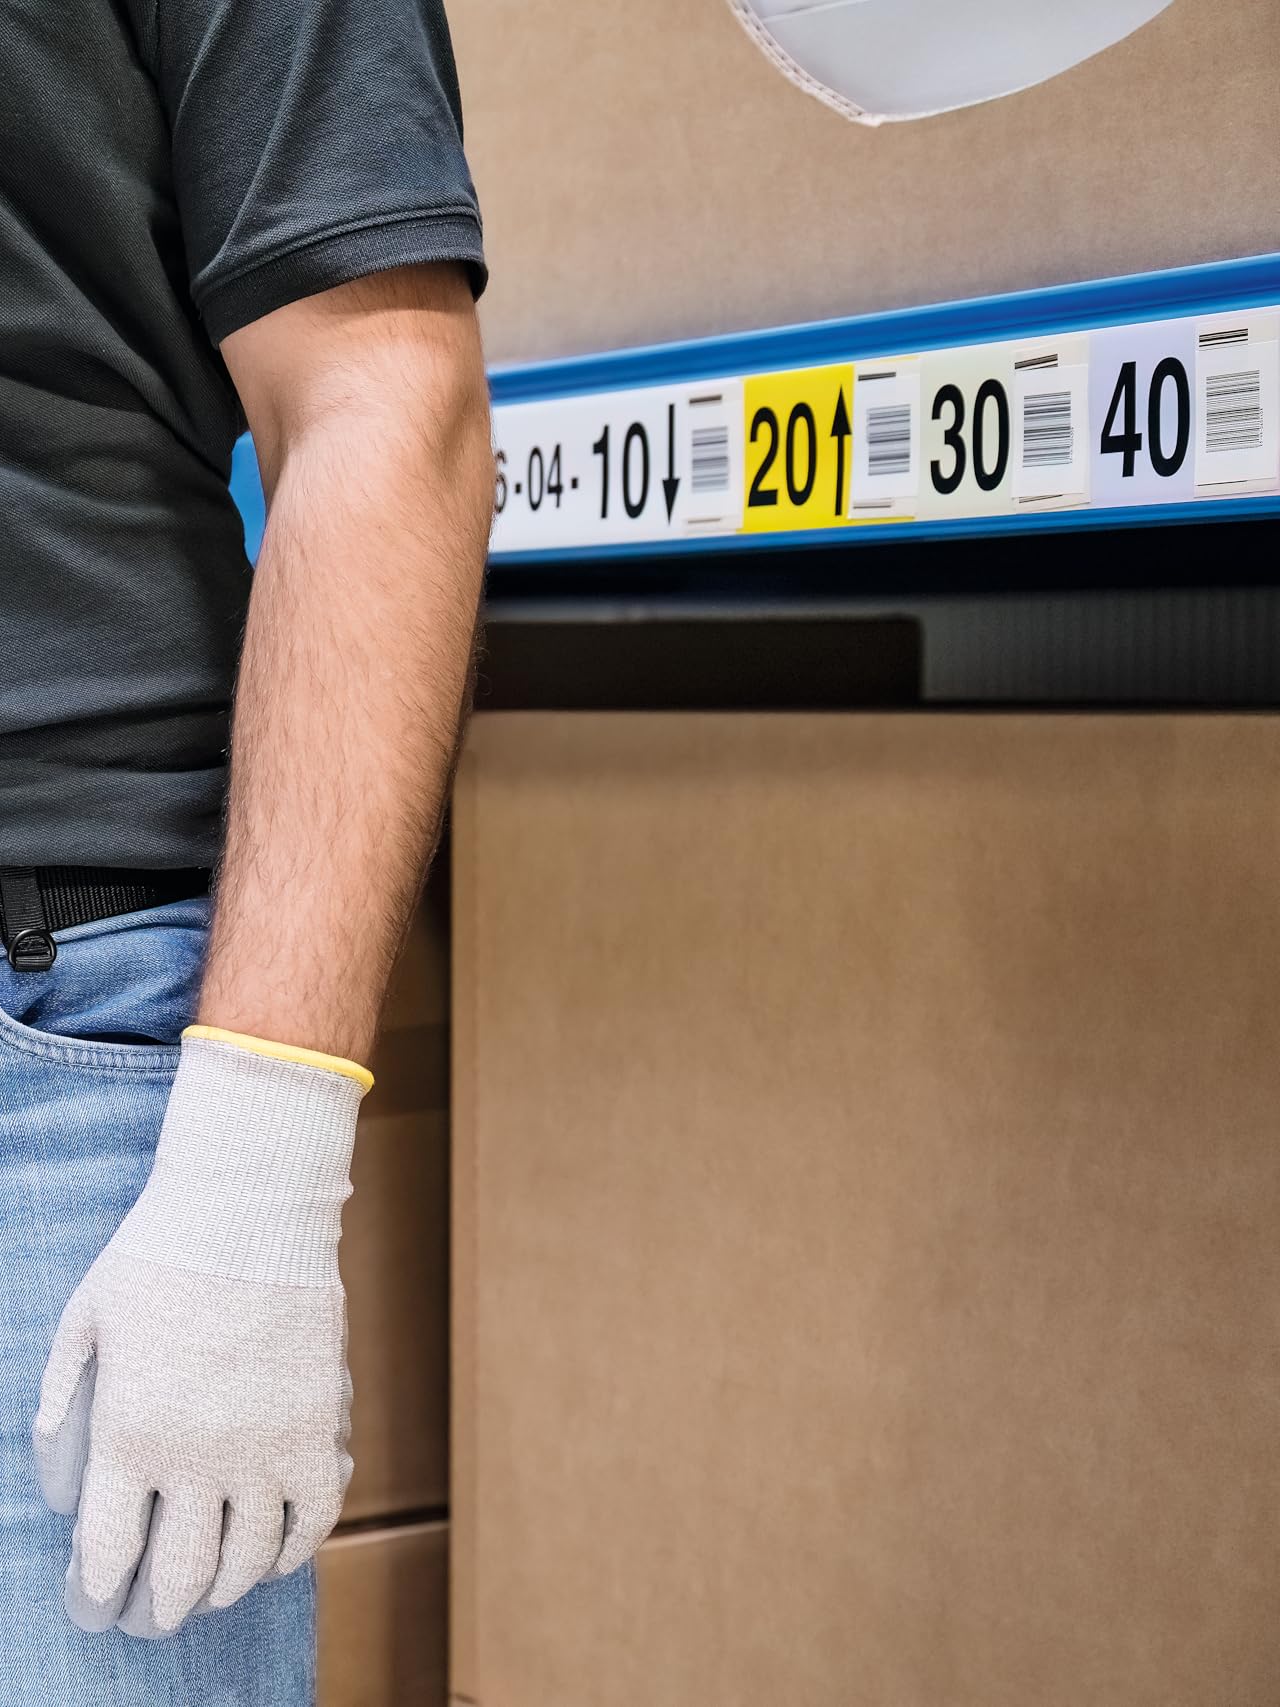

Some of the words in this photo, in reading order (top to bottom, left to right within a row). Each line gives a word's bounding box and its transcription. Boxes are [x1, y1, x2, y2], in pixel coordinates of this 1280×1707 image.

[747, 401, 817, 508] 20
[930, 378, 1010, 494] 30
[1100, 356, 1191, 478] 40
